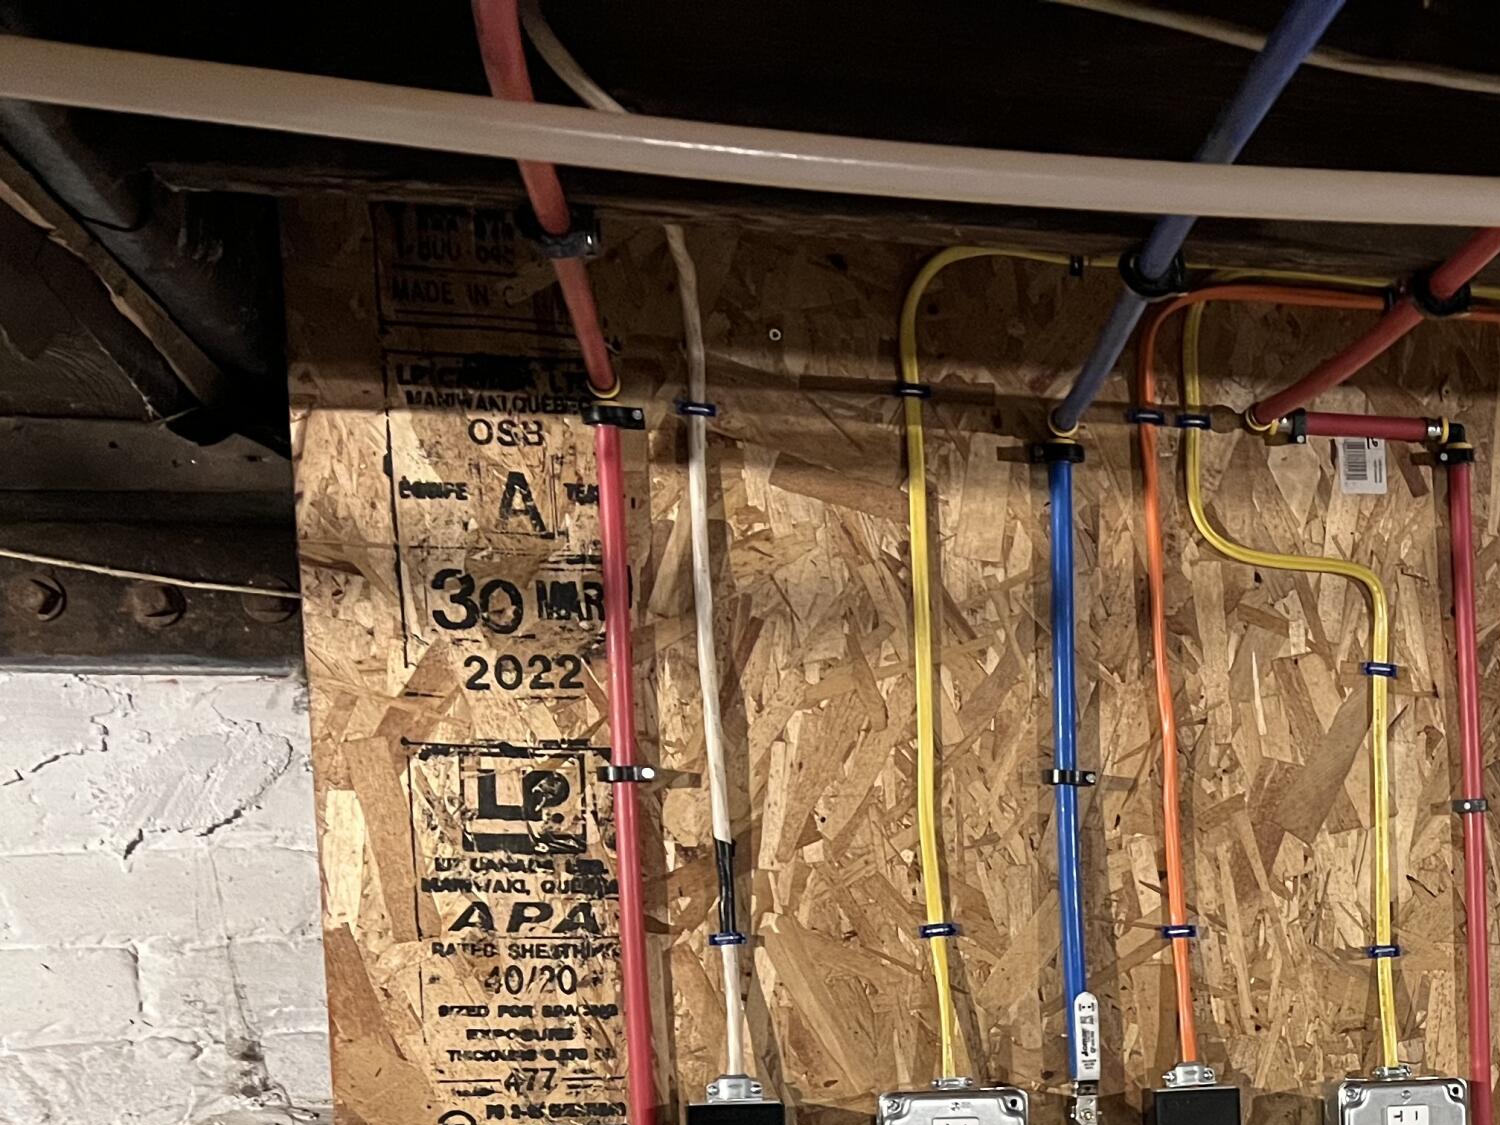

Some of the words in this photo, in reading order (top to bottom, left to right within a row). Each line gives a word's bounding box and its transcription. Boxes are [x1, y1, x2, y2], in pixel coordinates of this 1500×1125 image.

[467, 417, 547, 448] OSB
[499, 470, 550, 536] A
[430, 567, 524, 635] 30
[463, 653, 585, 691] 2022
[447, 900, 601, 935] APA
[431, 942, 499, 957] RATED
[484, 964, 578, 996] 40/20
